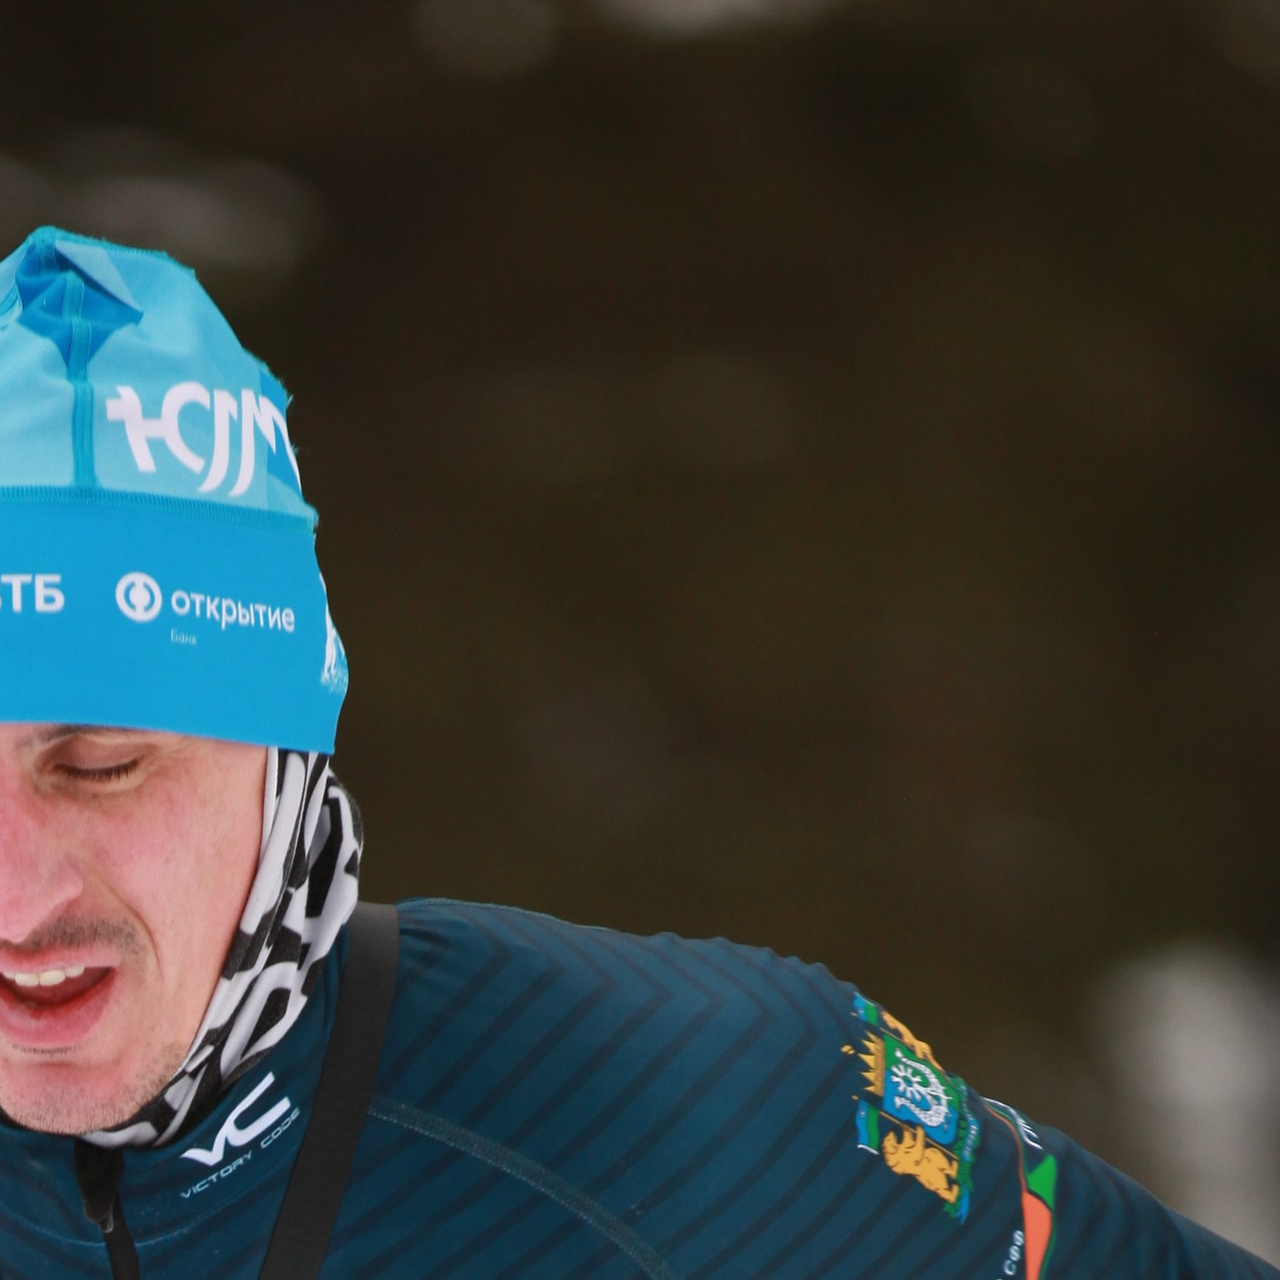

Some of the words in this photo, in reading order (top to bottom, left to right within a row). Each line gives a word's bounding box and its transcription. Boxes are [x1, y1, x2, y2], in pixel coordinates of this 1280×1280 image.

[170, 589, 296, 634] открытие
[180, 1150, 253, 1198] VICTORY
[260, 1107, 301, 1149] CODE
